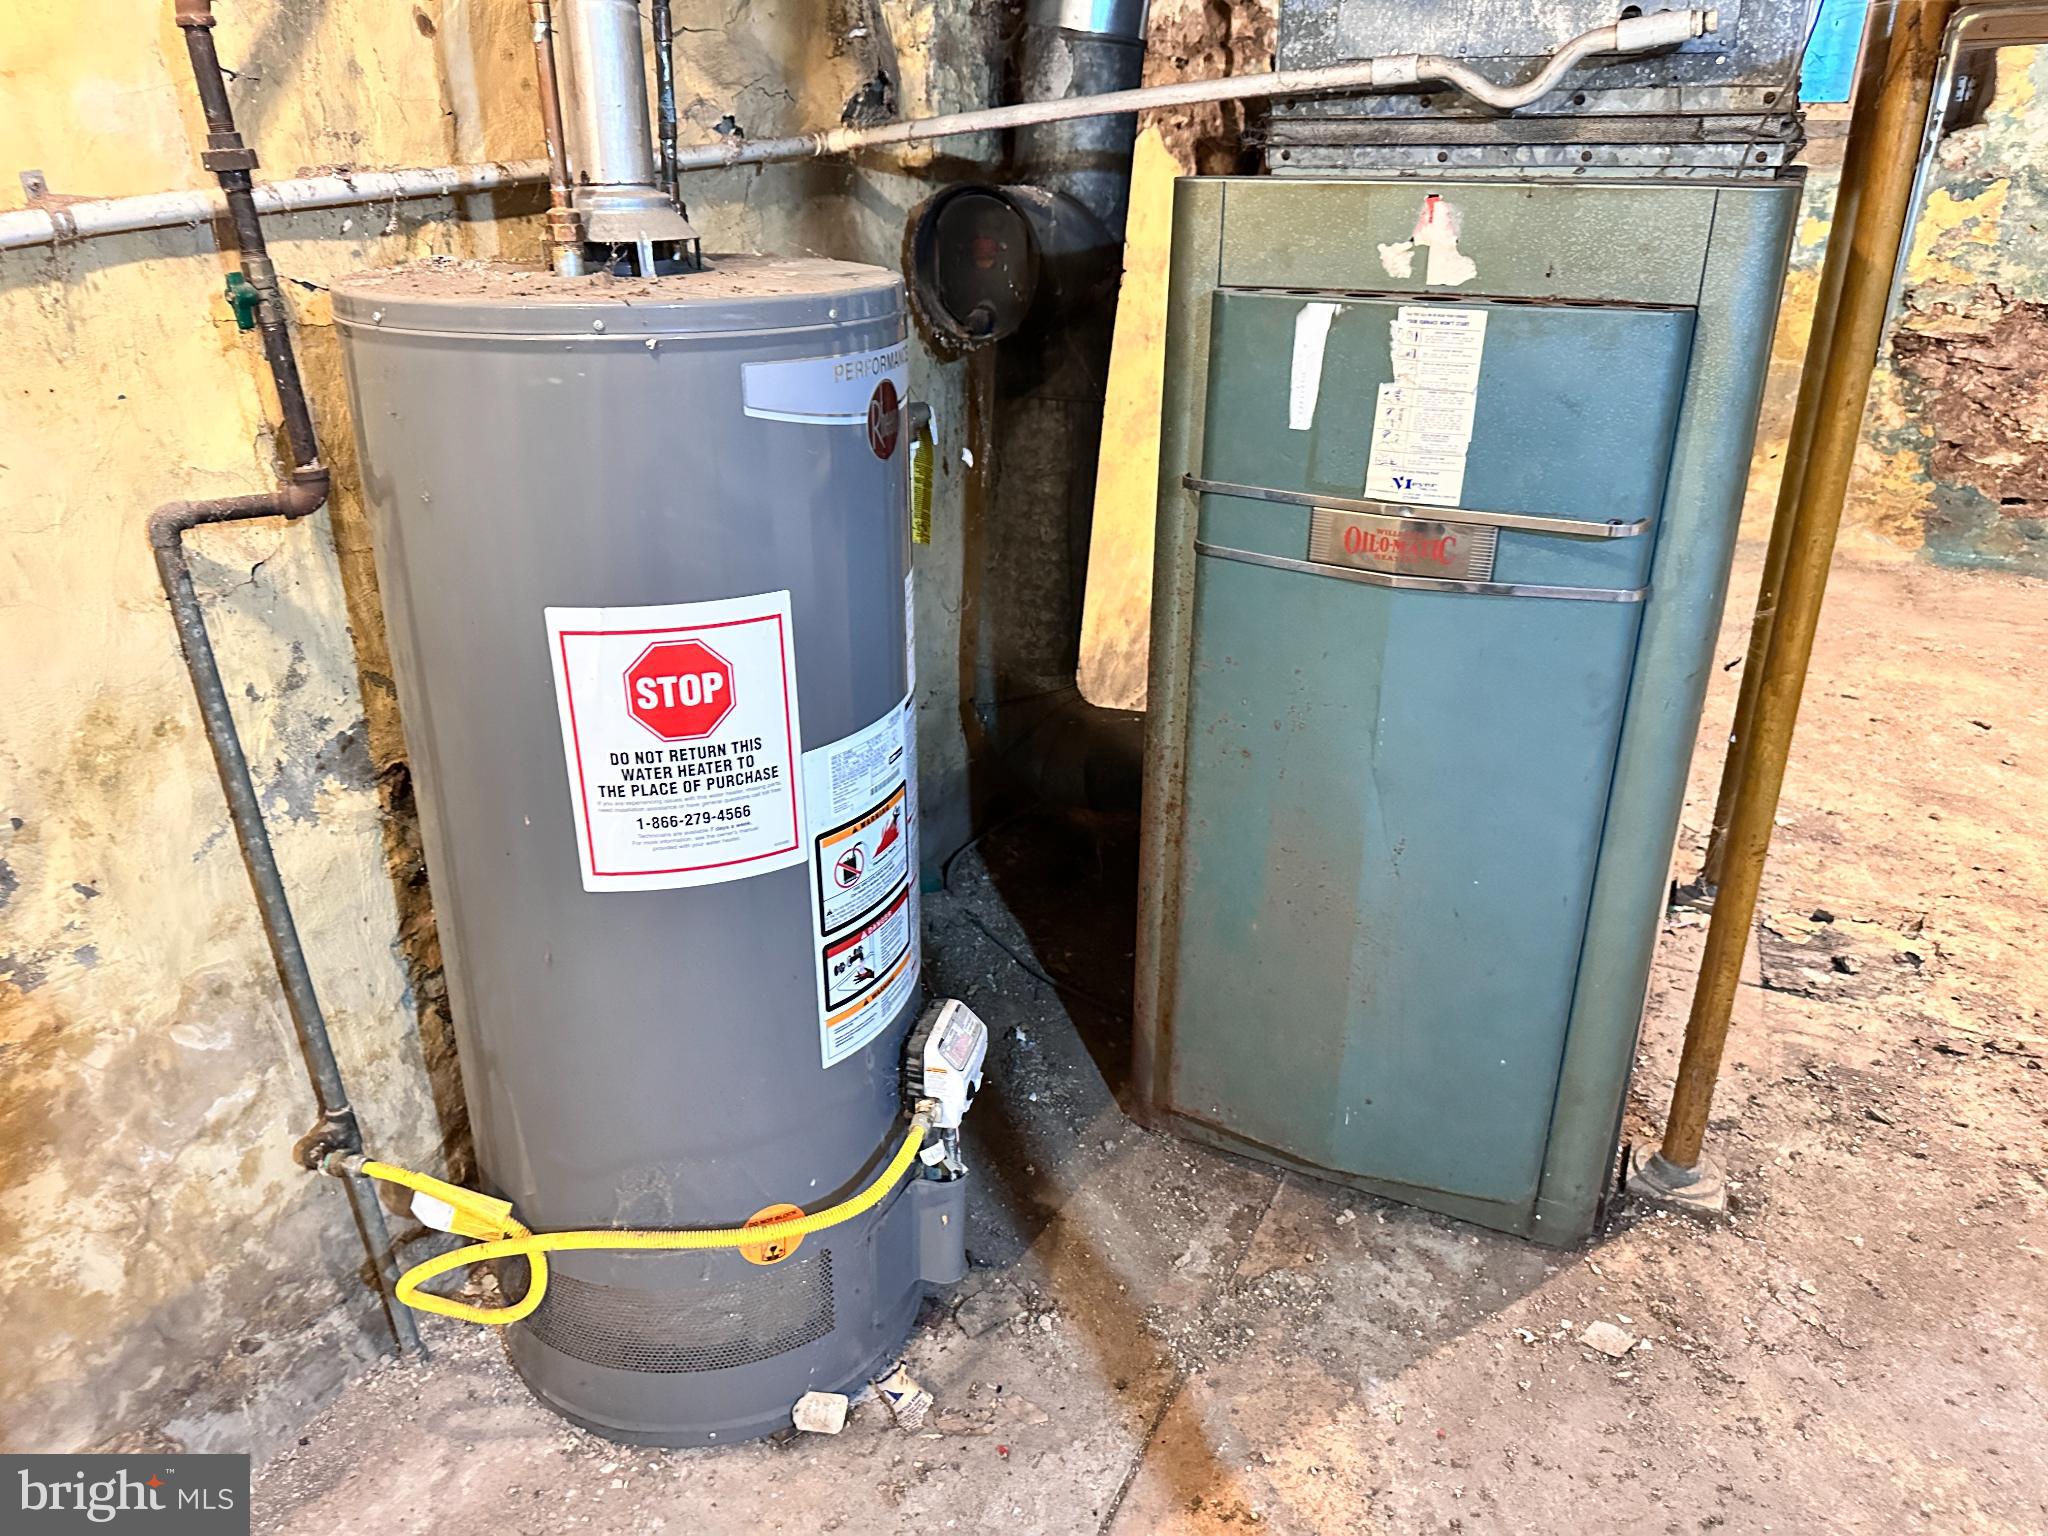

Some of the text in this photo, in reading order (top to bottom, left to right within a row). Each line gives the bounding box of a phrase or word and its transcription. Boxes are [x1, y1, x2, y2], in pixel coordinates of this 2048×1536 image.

[636, 672, 723, 710] STOP
[610, 737, 762, 766] DO NOT RETURN THIS
[597, 765, 779, 798] THE PLACE OF PURCHASE
[621, 755, 755, 781] WATER HEATER TO
[636, 805, 751, 829] 1-866-279-4566
